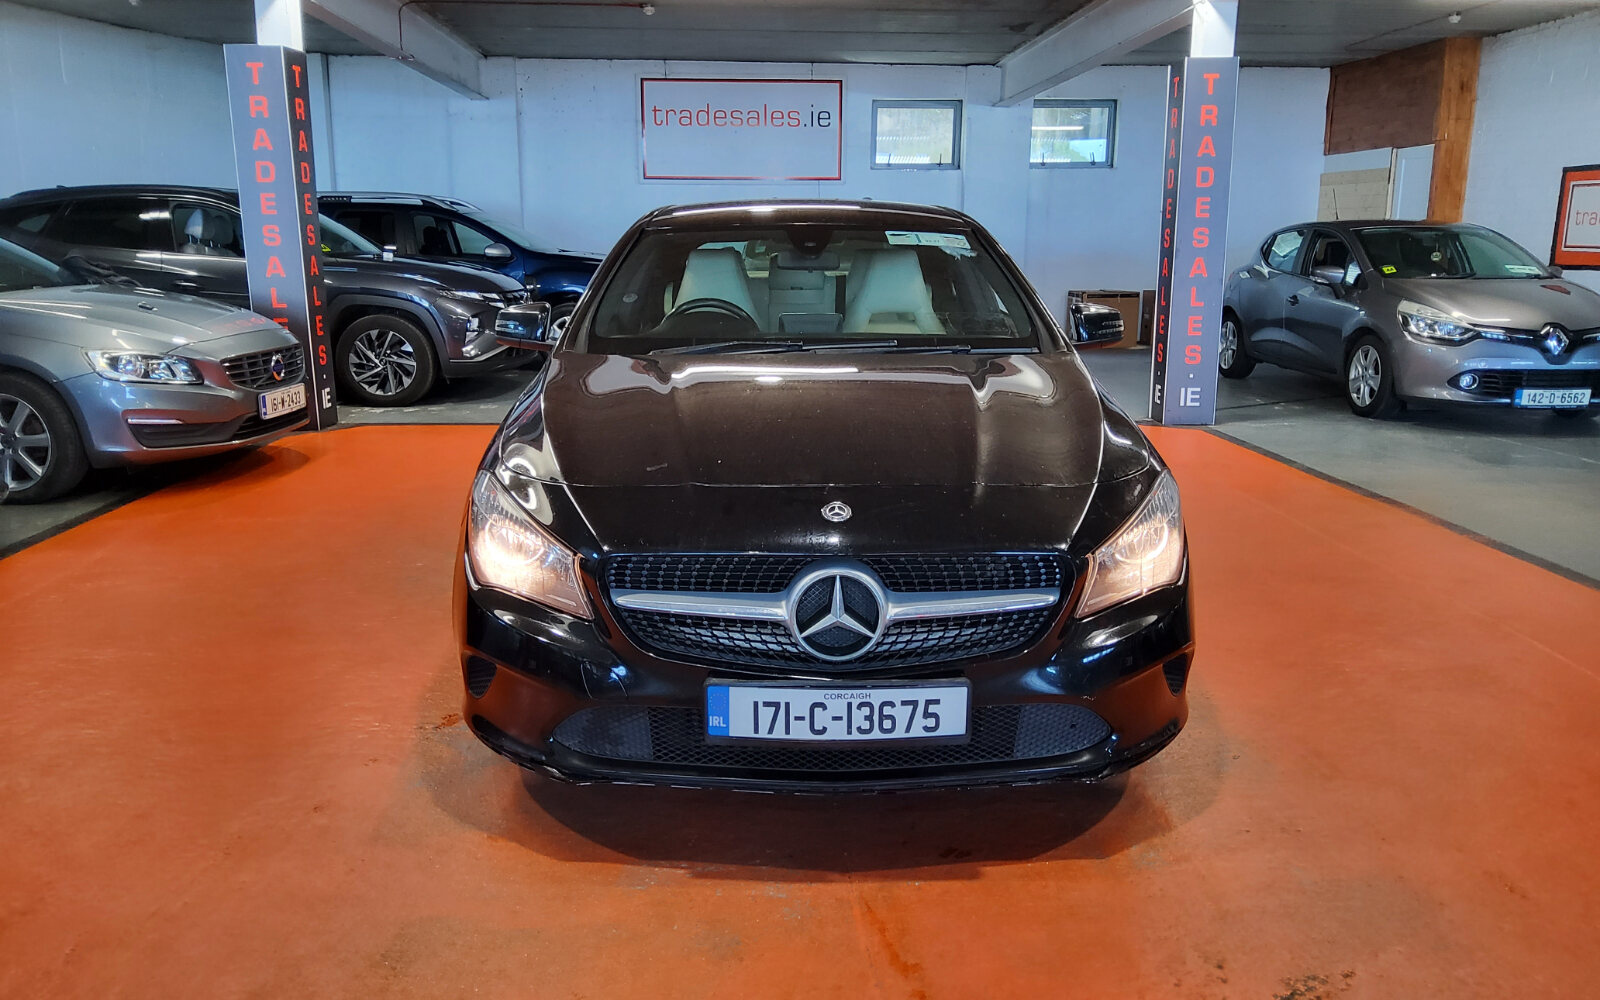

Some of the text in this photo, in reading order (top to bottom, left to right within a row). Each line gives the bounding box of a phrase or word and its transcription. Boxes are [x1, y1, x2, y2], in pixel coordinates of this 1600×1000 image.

[651, 103, 831, 128] tradesales.ie
[1575, 209, 1600, 226] tra
[1526, 392, 1587, 404] 142-D-6562
[823, 692, 872, 701] CORCAIGH
[708, 715, 727, 727] IRL
[753, 699, 941, 735] 171-C-13675
